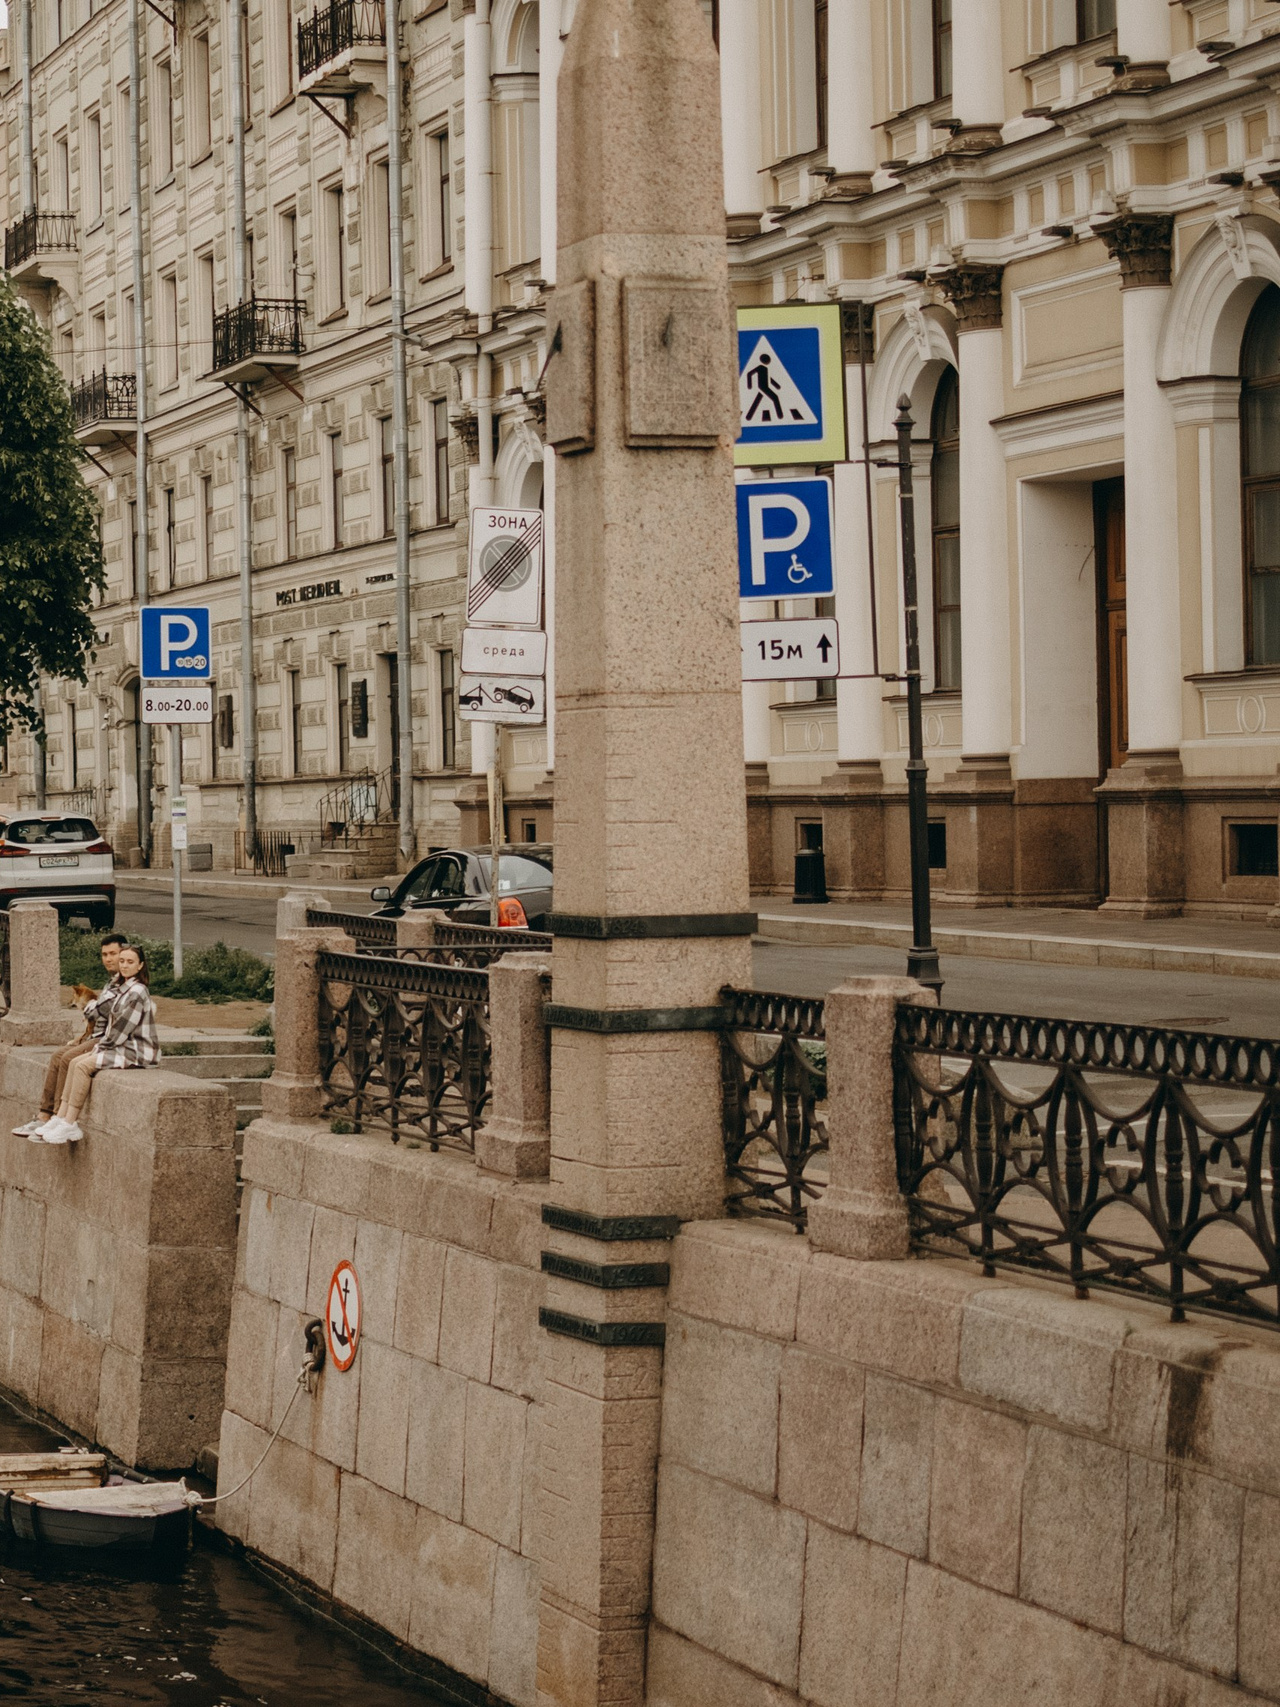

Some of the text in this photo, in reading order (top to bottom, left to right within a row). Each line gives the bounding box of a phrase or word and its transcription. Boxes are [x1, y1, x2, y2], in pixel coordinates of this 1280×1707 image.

[488, 515, 528, 530] ЗОНА
[748, 493, 811, 586] P
[160, 614, 198, 671] P
[483, 646, 525, 657] среда
[194, 657, 206, 667] 20
[145, 699, 209, 712] 8.00-20.00
